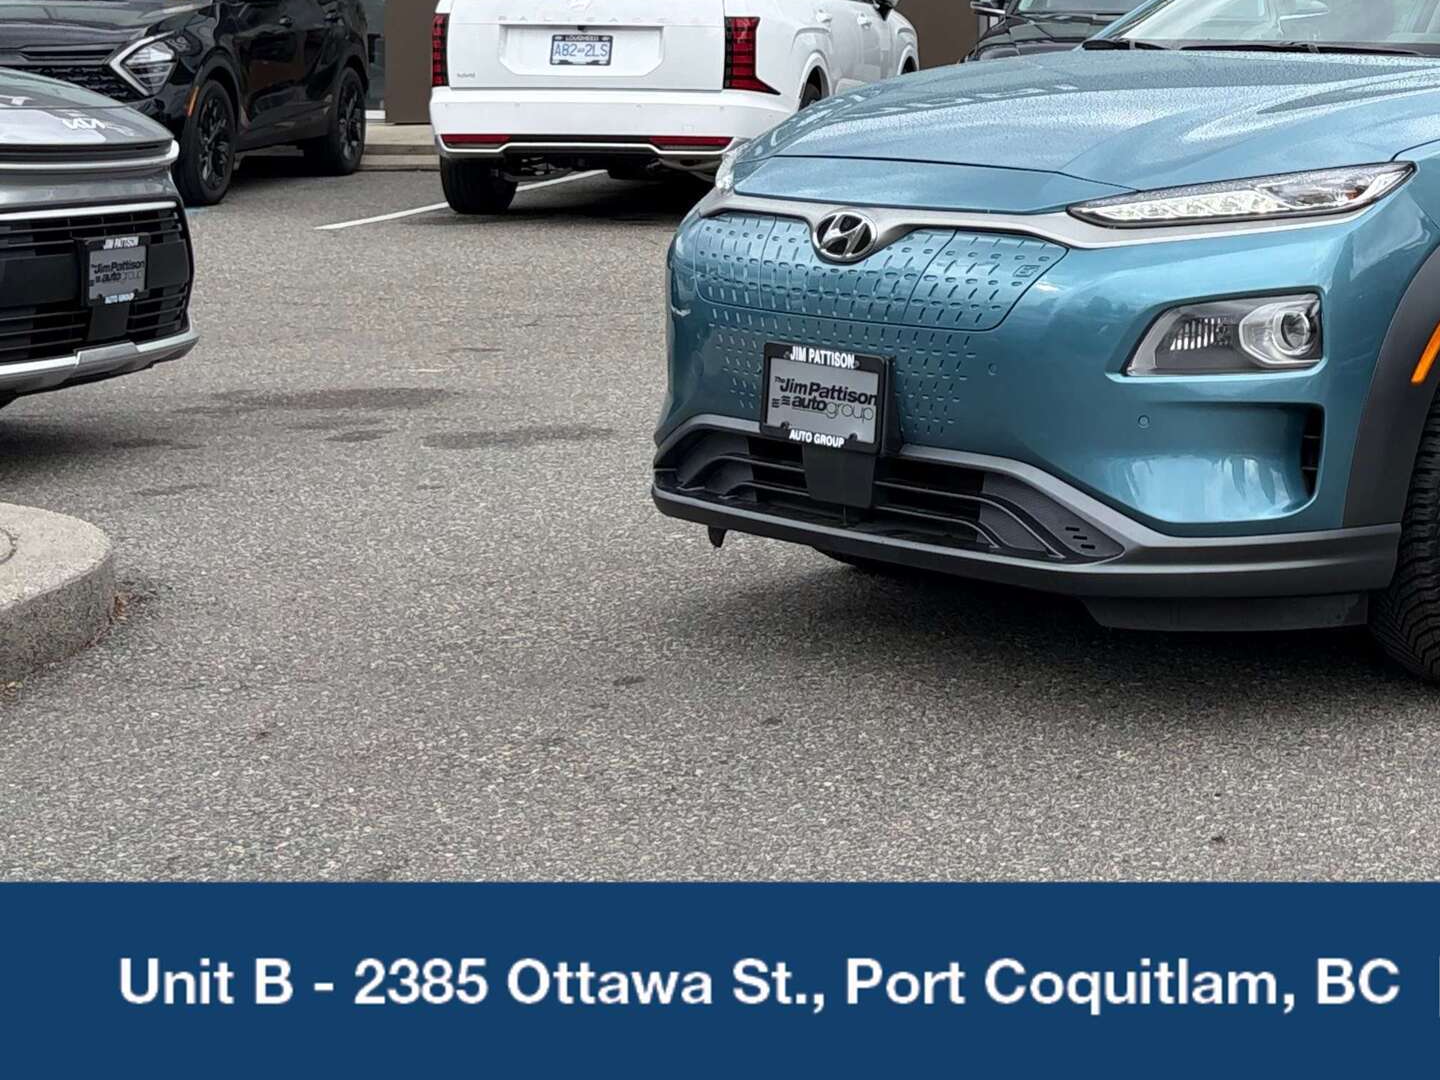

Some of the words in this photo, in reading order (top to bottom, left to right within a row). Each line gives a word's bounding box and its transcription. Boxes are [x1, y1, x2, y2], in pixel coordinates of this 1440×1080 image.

[790, 346, 806, 361] JIM
[808, 348, 855, 369] PATTISON
[789, 429, 812, 443] AUTO
[814, 433, 845, 448] GROUP
